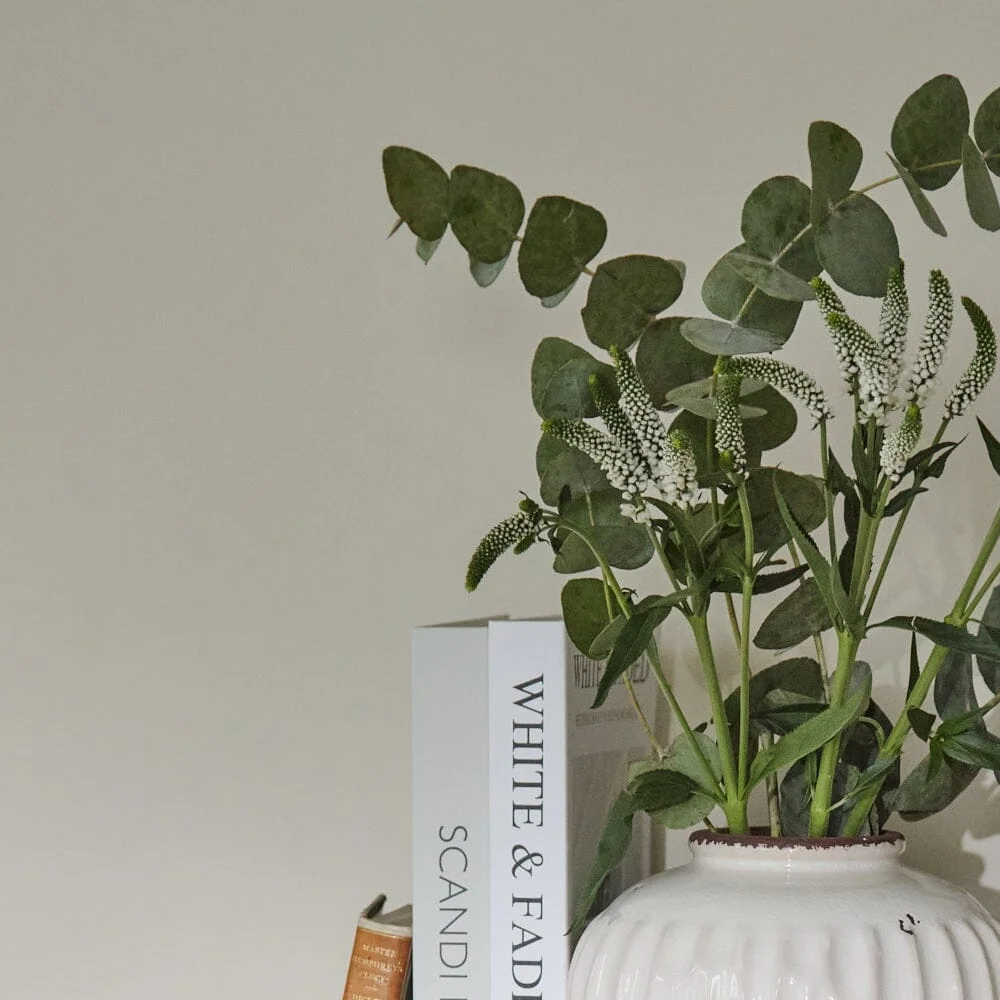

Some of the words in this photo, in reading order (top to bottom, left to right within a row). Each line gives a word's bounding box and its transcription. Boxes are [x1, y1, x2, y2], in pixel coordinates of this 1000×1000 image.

[511, 672, 545, 830] WHITE
[438, 825, 470, 979] SCANDI
[511, 843, 544, 879] &
[362, 944, 397, 958] MASTER
